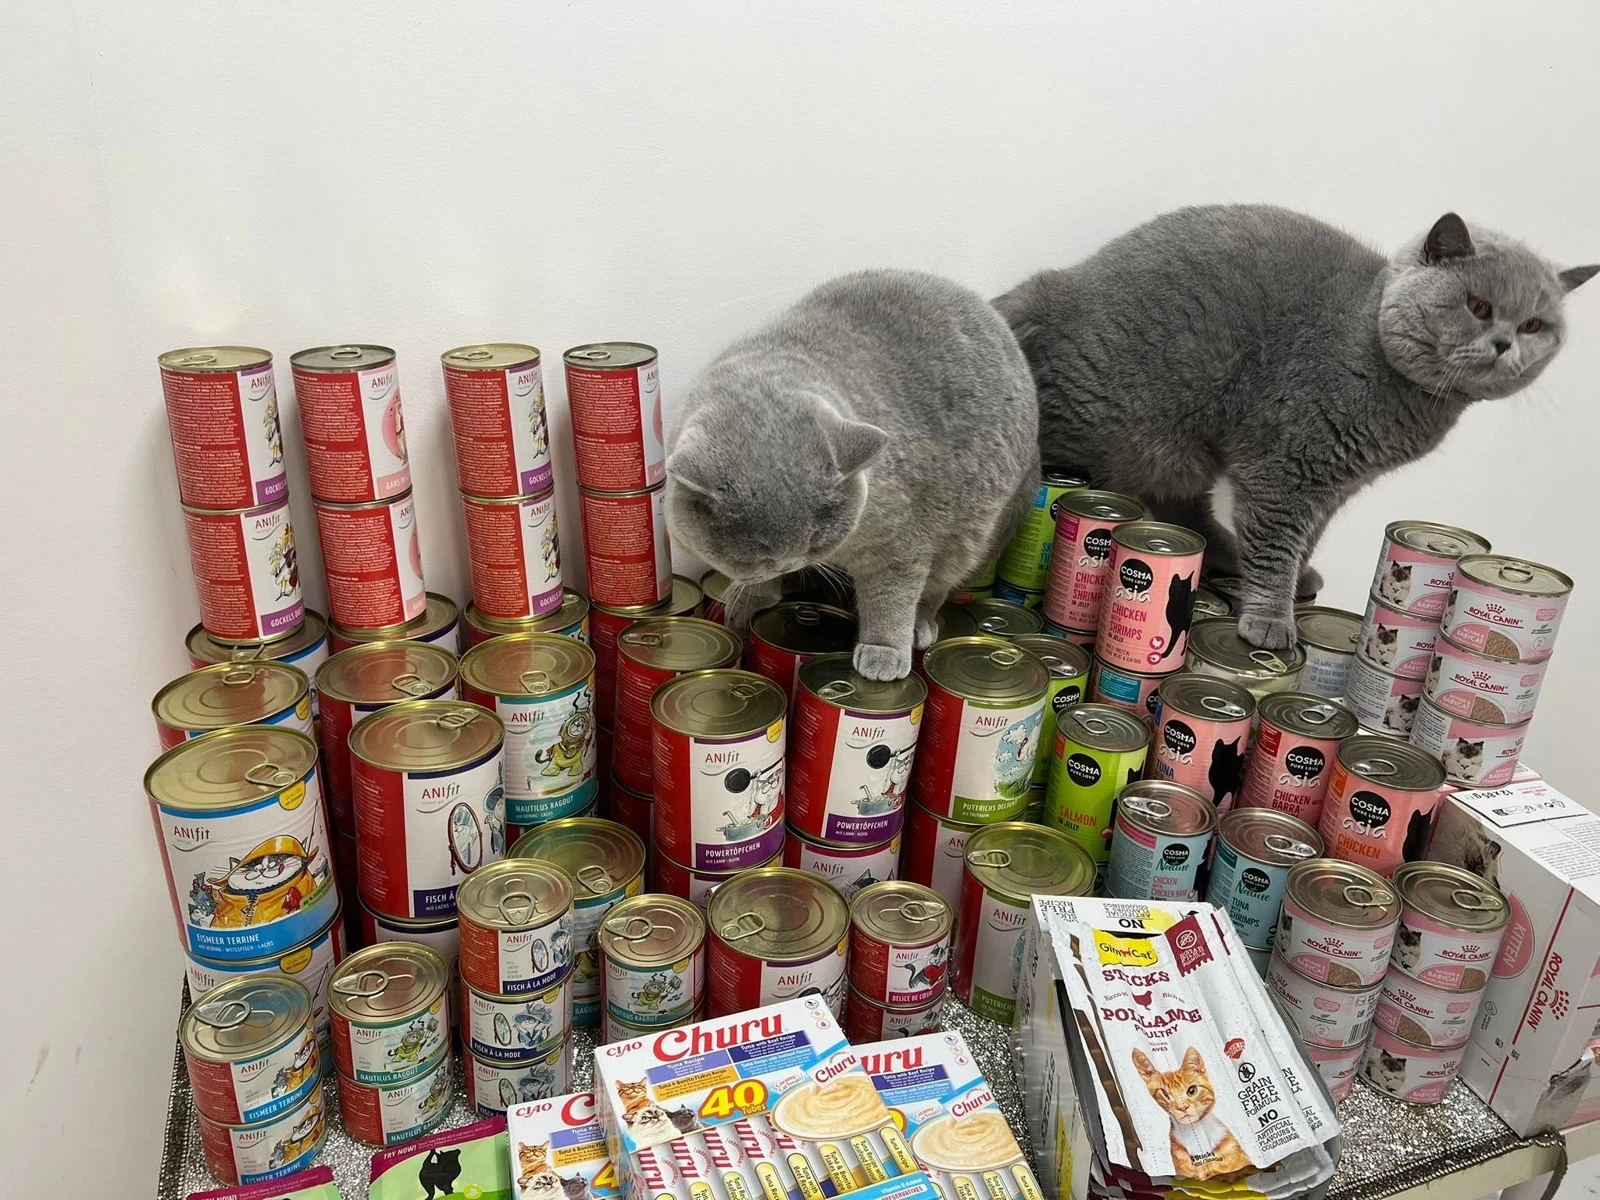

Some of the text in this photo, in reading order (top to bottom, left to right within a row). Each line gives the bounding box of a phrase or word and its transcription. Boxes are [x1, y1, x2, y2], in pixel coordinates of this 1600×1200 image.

[255, 514, 281, 530] ANIfit
[1121, 566, 1153, 583] COSMA
[1123, 575, 1147, 586] PURE LOVE
[1430, 578, 1453, 588] ROYAL
[1115, 585, 1152, 604] asia
[1112, 603, 1147, 623] CHICKEN
[1469, 606, 1520, 627] ROYAL CANIN
[1109, 623, 1143, 641] SHRIMPS
[1456, 630, 1484, 645] BABYCAT
[1455, 674, 1505, 693] ROYAL CANIN
[1442, 696, 1470, 711] BABYCAT
[511, 709, 546, 724] ANIfit
[975, 715, 1009, 730] ANIfit
[852, 725, 886, 740] ANIfit
[1164, 725, 1195, 745] COSMA
[1166, 735, 1190, 750] PURE LOVE
[704, 750, 740, 765] ANIfit
[1159, 744, 1194, 766] asia
[1288, 752, 1324, 767] COSMA
[1068, 758, 1100, 777] COSMA
[1070, 768, 1095, 782] PURE LOVE
[1156, 759, 1174, 780] TUNA
[1278, 771, 1321, 790] asia
[422, 782, 460, 800] ANIfit
[1274, 788, 1311, 806] CHICKEN
[515, 795, 575, 815] NAUTILUS RAGOUT
[962, 798, 1018, 813] PUTERICHS DELIGHT
[1272, 799, 1304, 816] BARRA-
[1351, 796, 1390, 819] COSMA
[1058, 804, 1097, 828] SALMON
[1354, 808, 1384, 823] PURE LOVE
[836, 818, 889, 832] POWERTÖPFCHEN
[1064, 818, 1080, 832] JELLY
[1343, 817, 1388, 842] asia
[174, 825, 211, 847] ANIfit
[705, 841, 762, 858] POWERTÖPFCHEN
[1164, 848, 1189, 857] COSMA
[1337, 833, 1382, 861] CHICKEN
[812, 860, 845, 876] ANIfit
[1153, 876, 1178, 887] CHICKEN
[1242, 871, 1270, 886] COSMA
[425, 893, 447, 905] FISCH
[1150, 888, 1176, 899] CHICKEN
[434, 904, 450, 912] LACHS
[1038, 899, 1073, 908] RECIPE
[1102, 902, 1149, 910] COLOURINGS
[1232, 896, 1250, 912] TUNA
[992, 908, 1027, 926] ANIfit
[1107, 912, 1151, 920] ARTIFICIAL
[1118, 918, 1146, 930] NO
[1228, 910, 1261, 930] SHRIMPS
[196, 932, 260, 947] EISMEER TERRINE
[258, 941, 274, 951] LACHS
[506, 932, 534, 945] ANIfit
[1502, 920, 1527, 970] KITTEN
[1306, 937, 1358, 958] ROYAL CANIN
[1442, 949, 1492, 962] ROYAL CANIN
[895, 952, 919, 964] ANIfit
[190, 965, 216, 988] ANIfit
[507, 972, 556, 994] FISCH LA MODE
[776, 970, 812, 988] ANIfit
[1102, 968, 1170, 988] STICKS
[1427, 971, 1460, 986] BABYCAT
[892, 993, 919, 1005] DELICE DE
[1162, 992, 1176, 1002] Rich
[1278, 986, 1299, 1005] CANIN
[1526, 951, 1564, 1031] ROYAL CANIN
[474, 998, 495, 1012] ANIfit
[1382, 986, 1431, 1018] ROYAL CANIN
[634, 1014, 658, 1023] RAGOUT
[889, 1016, 913, 1028] ANIfit
[1100, 1006, 1203, 1029] POLLAME
[356, 1029, 382, 1039] ANIfit
[606, 1041, 643, 1058] CIAO
[652, 1014, 784, 1062] Churu
[1134, 1024, 1179, 1039] POULTRY
[740, 1044, 756, 1052] Tuna
[756, 1041, 768, 1050] with
[768, 1038, 780, 1046] Beef
[780, 1034, 797, 1044] Recipe
[474, 1044, 522, 1060] FISCH LA MODE
[240, 1058, 270, 1075] ANIfit
[667, 1056, 706, 1070] Tuna Recipe
[740, 1059, 770, 1070] Tuna Recipe
[814, 1054, 857, 1083] Churu
[360, 1067, 419, 1084] NAUTILUS RAGOUT
[478, 1066, 500, 1080] ANIfit
[658, 1082, 672, 1090] Tuna
[676, 1076, 695, 1087] Bonito
[694, 1072, 712, 1082] Flakes
[711, 1068, 728, 1078] Recipe
[883, 1073, 897, 1082] Tuna
[897, 1072, 908, 1080] with
[919, 1066, 936, 1076] Recipe
[387, 1086, 414, 1101] ANIfit
[1238, 1076, 1273, 1100] GRAIN
[248, 1089, 304, 1122] EISMEER TERRINE
[699, 1080, 768, 1118] 40
[951, 1091, 993, 1118] Churu
[1241, 1085, 1280, 1112] FREE
[480, 1108, 494, 1119] FISCH
[515, 1102, 553, 1118] CIAO
[742, 1103, 767, 1116] Tubes
[1246, 1096, 1282, 1118] FORMULA
[1258, 1108, 1279, 1129] NO
[238, 1129, 268, 1143] ANIfit
[390, 1126, 422, 1142] NAUTILUS
[572, 1128, 588, 1136] Tuna
[1257, 1119, 1294, 1144] ARTIFICIAL
[1258, 1128, 1291, 1148] FLAVOURS
[558, 1144, 596, 1157] Tuna Bonito
[1262, 1133, 1300, 1155] COLOURINGS
[383, 1144, 417, 1161] TRY NOW!
[889, 1138, 911, 1170] Tuna Recipe
[274, 1160, 301, 1179] TERRINE
[764, 1174, 774, 1186] Tuna
[906, 1178, 924, 1188] Added
[990, 1175, 1001, 1187] Tuna
